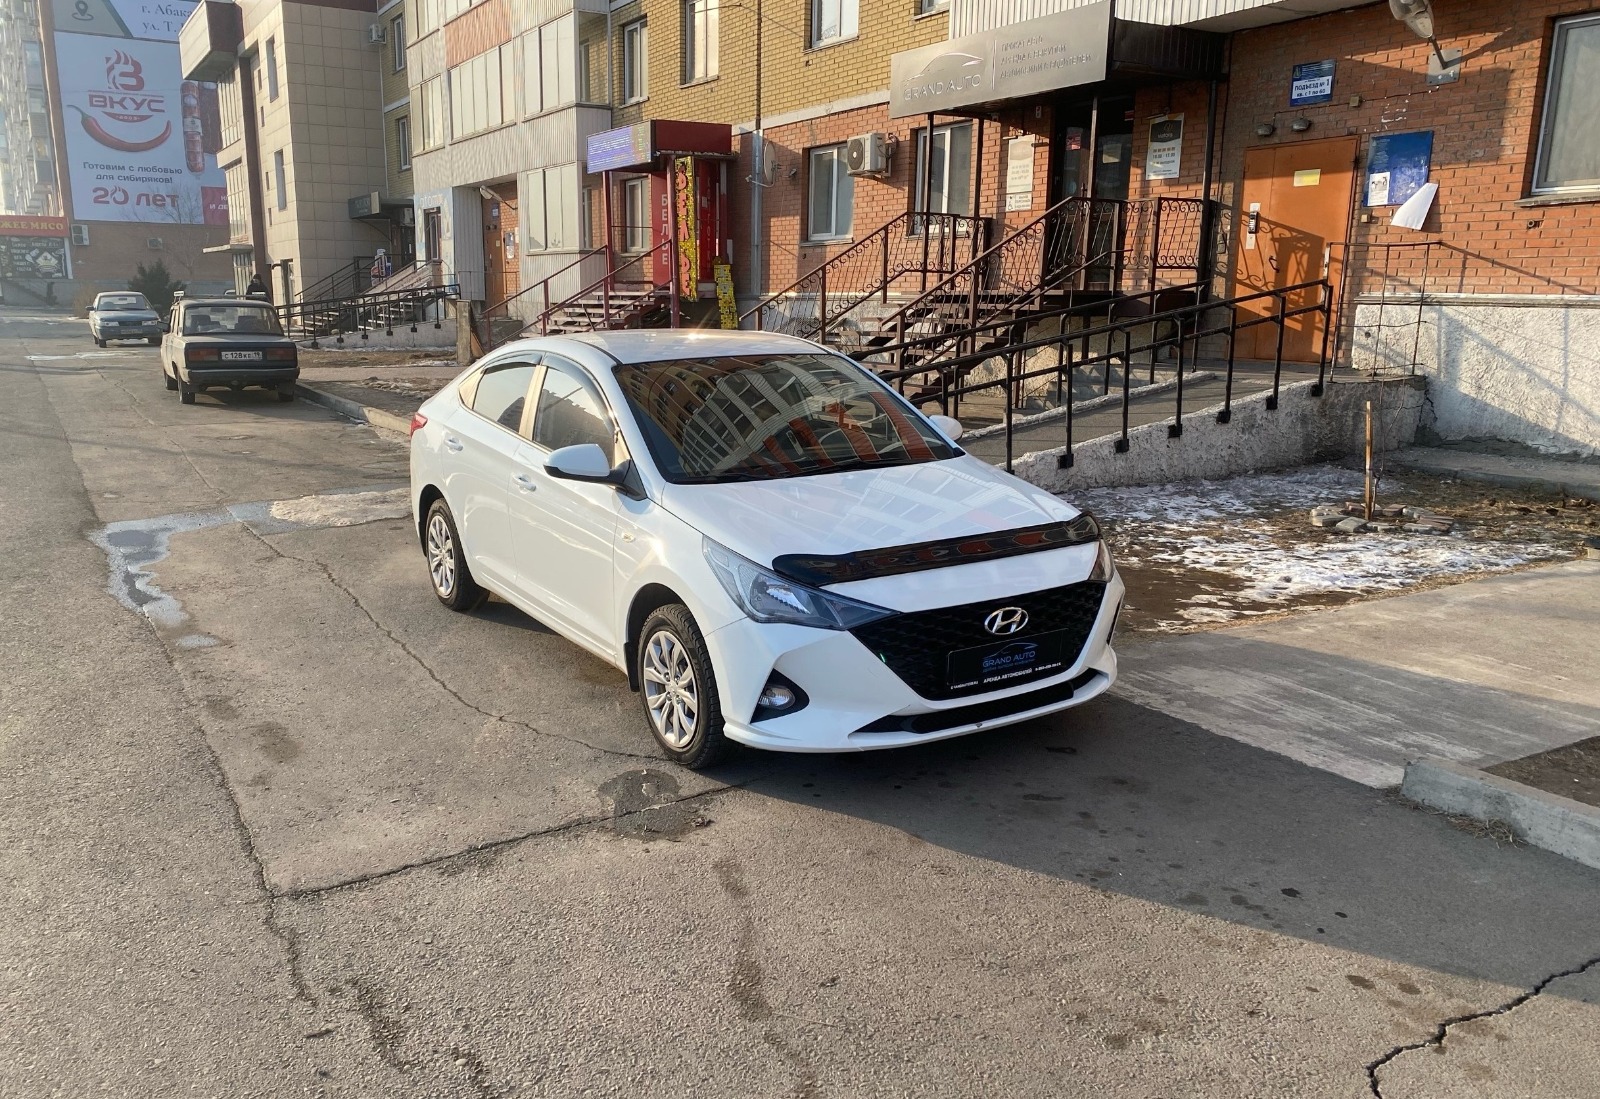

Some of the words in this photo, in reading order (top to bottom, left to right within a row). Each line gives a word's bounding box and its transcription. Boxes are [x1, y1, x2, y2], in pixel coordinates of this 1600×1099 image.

[155, 4, 192, 17] Абака
[904, 82, 944, 101] GRAND
[946, 74, 981, 93] AUTO
[1295, 83, 1318, 91] ПОДЪЕЗД
[88, 94, 166, 112] ВКУС
[83, 161, 126, 171] Готовим
[137, 166, 183, 174] любовью
[117, 174, 173, 184] сибиряков!
[92, 185, 130, 206] 20
[135, 193, 180, 208] лет
[30, 221, 64, 230] МЯСО
[660, 194, 669, 265] БЕЛЬЕ
[982, 656, 1012, 668] GRAND
[1013, 650, 1036, 661] AUTO
